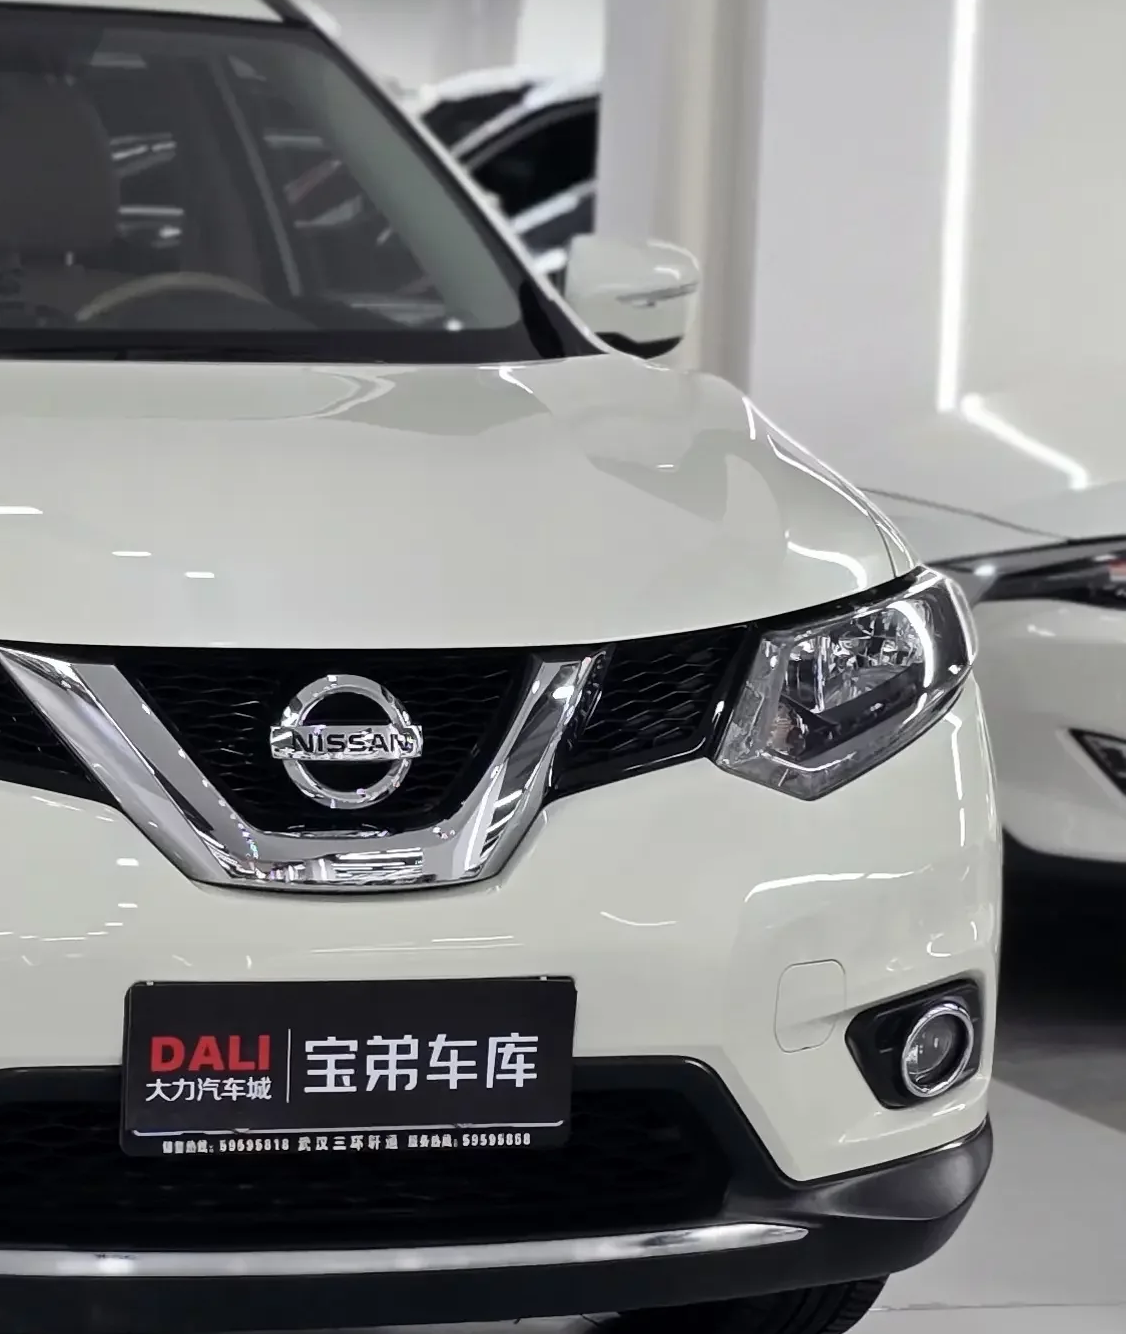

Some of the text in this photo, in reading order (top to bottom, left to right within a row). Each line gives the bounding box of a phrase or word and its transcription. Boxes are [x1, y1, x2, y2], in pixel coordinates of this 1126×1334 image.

[292, 734, 414, 753] NISSAN
[151, 1034, 271, 1072] DALI
[304, 1032, 539, 1093] 宝弟车库
[145, 1076, 272, 1102] 大力汽车城
